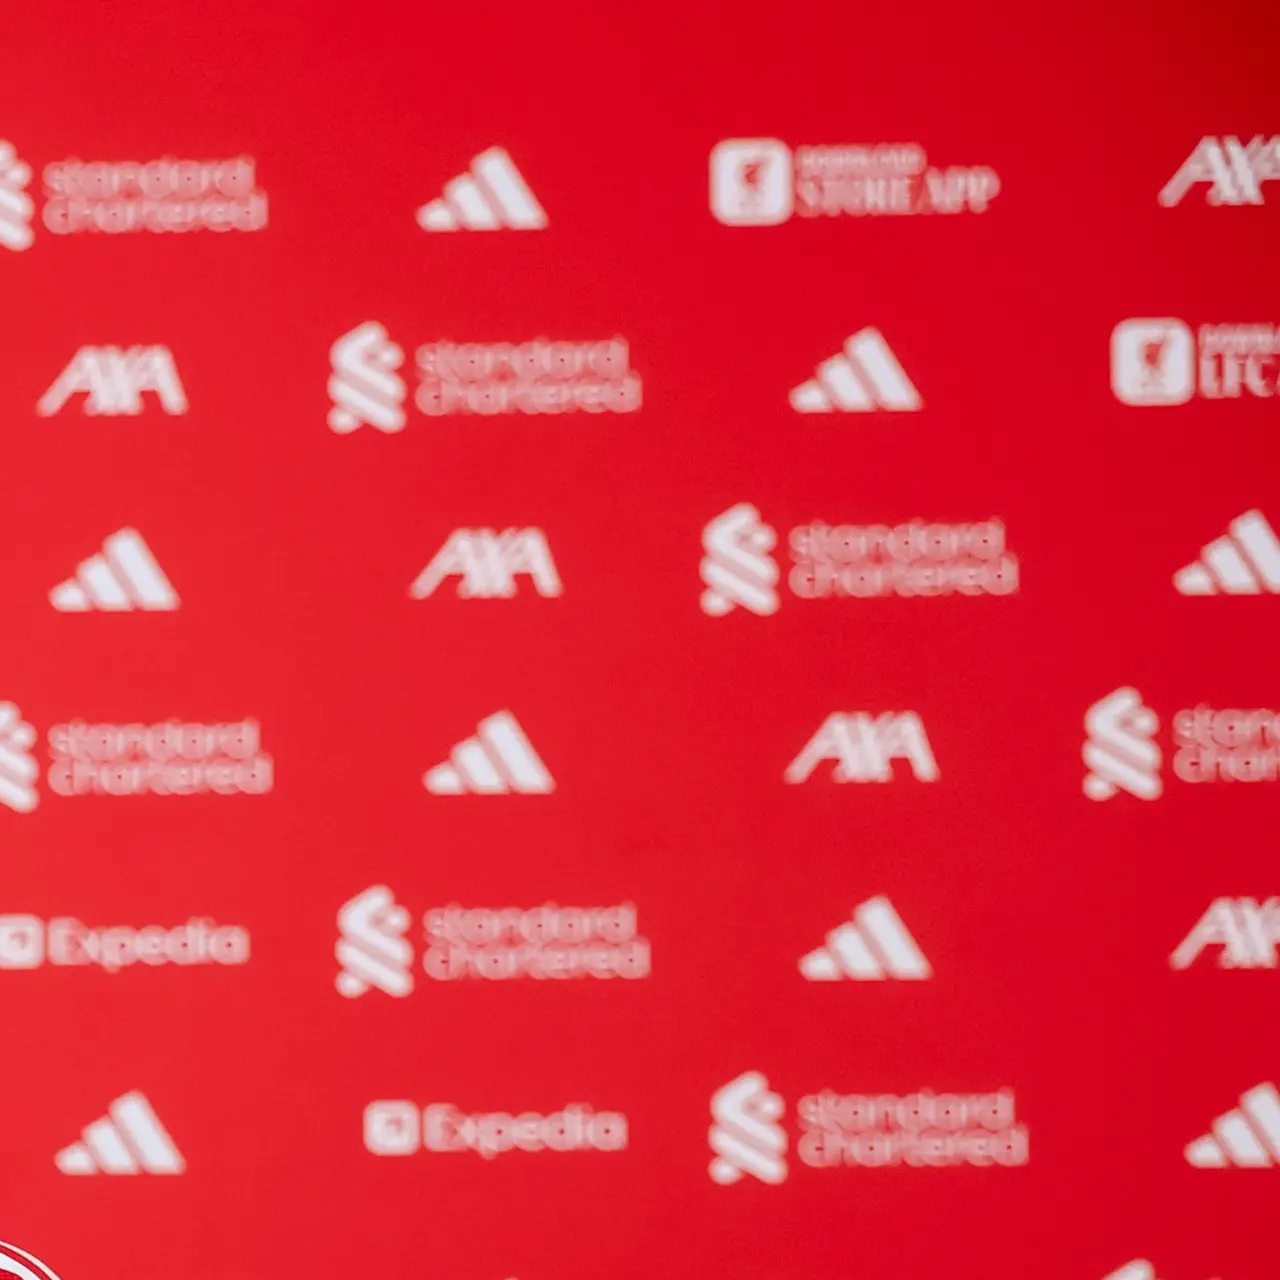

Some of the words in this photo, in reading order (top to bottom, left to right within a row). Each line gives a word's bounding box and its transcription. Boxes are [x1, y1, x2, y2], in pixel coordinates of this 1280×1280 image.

[37, 344, 189, 416] AXA
[410, 526, 563, 599] AXA
[784, 710, 940, 784] AXA
[46, 917, 250, 972] Expedia
[421, 1103, 628, 1159] Expedia
